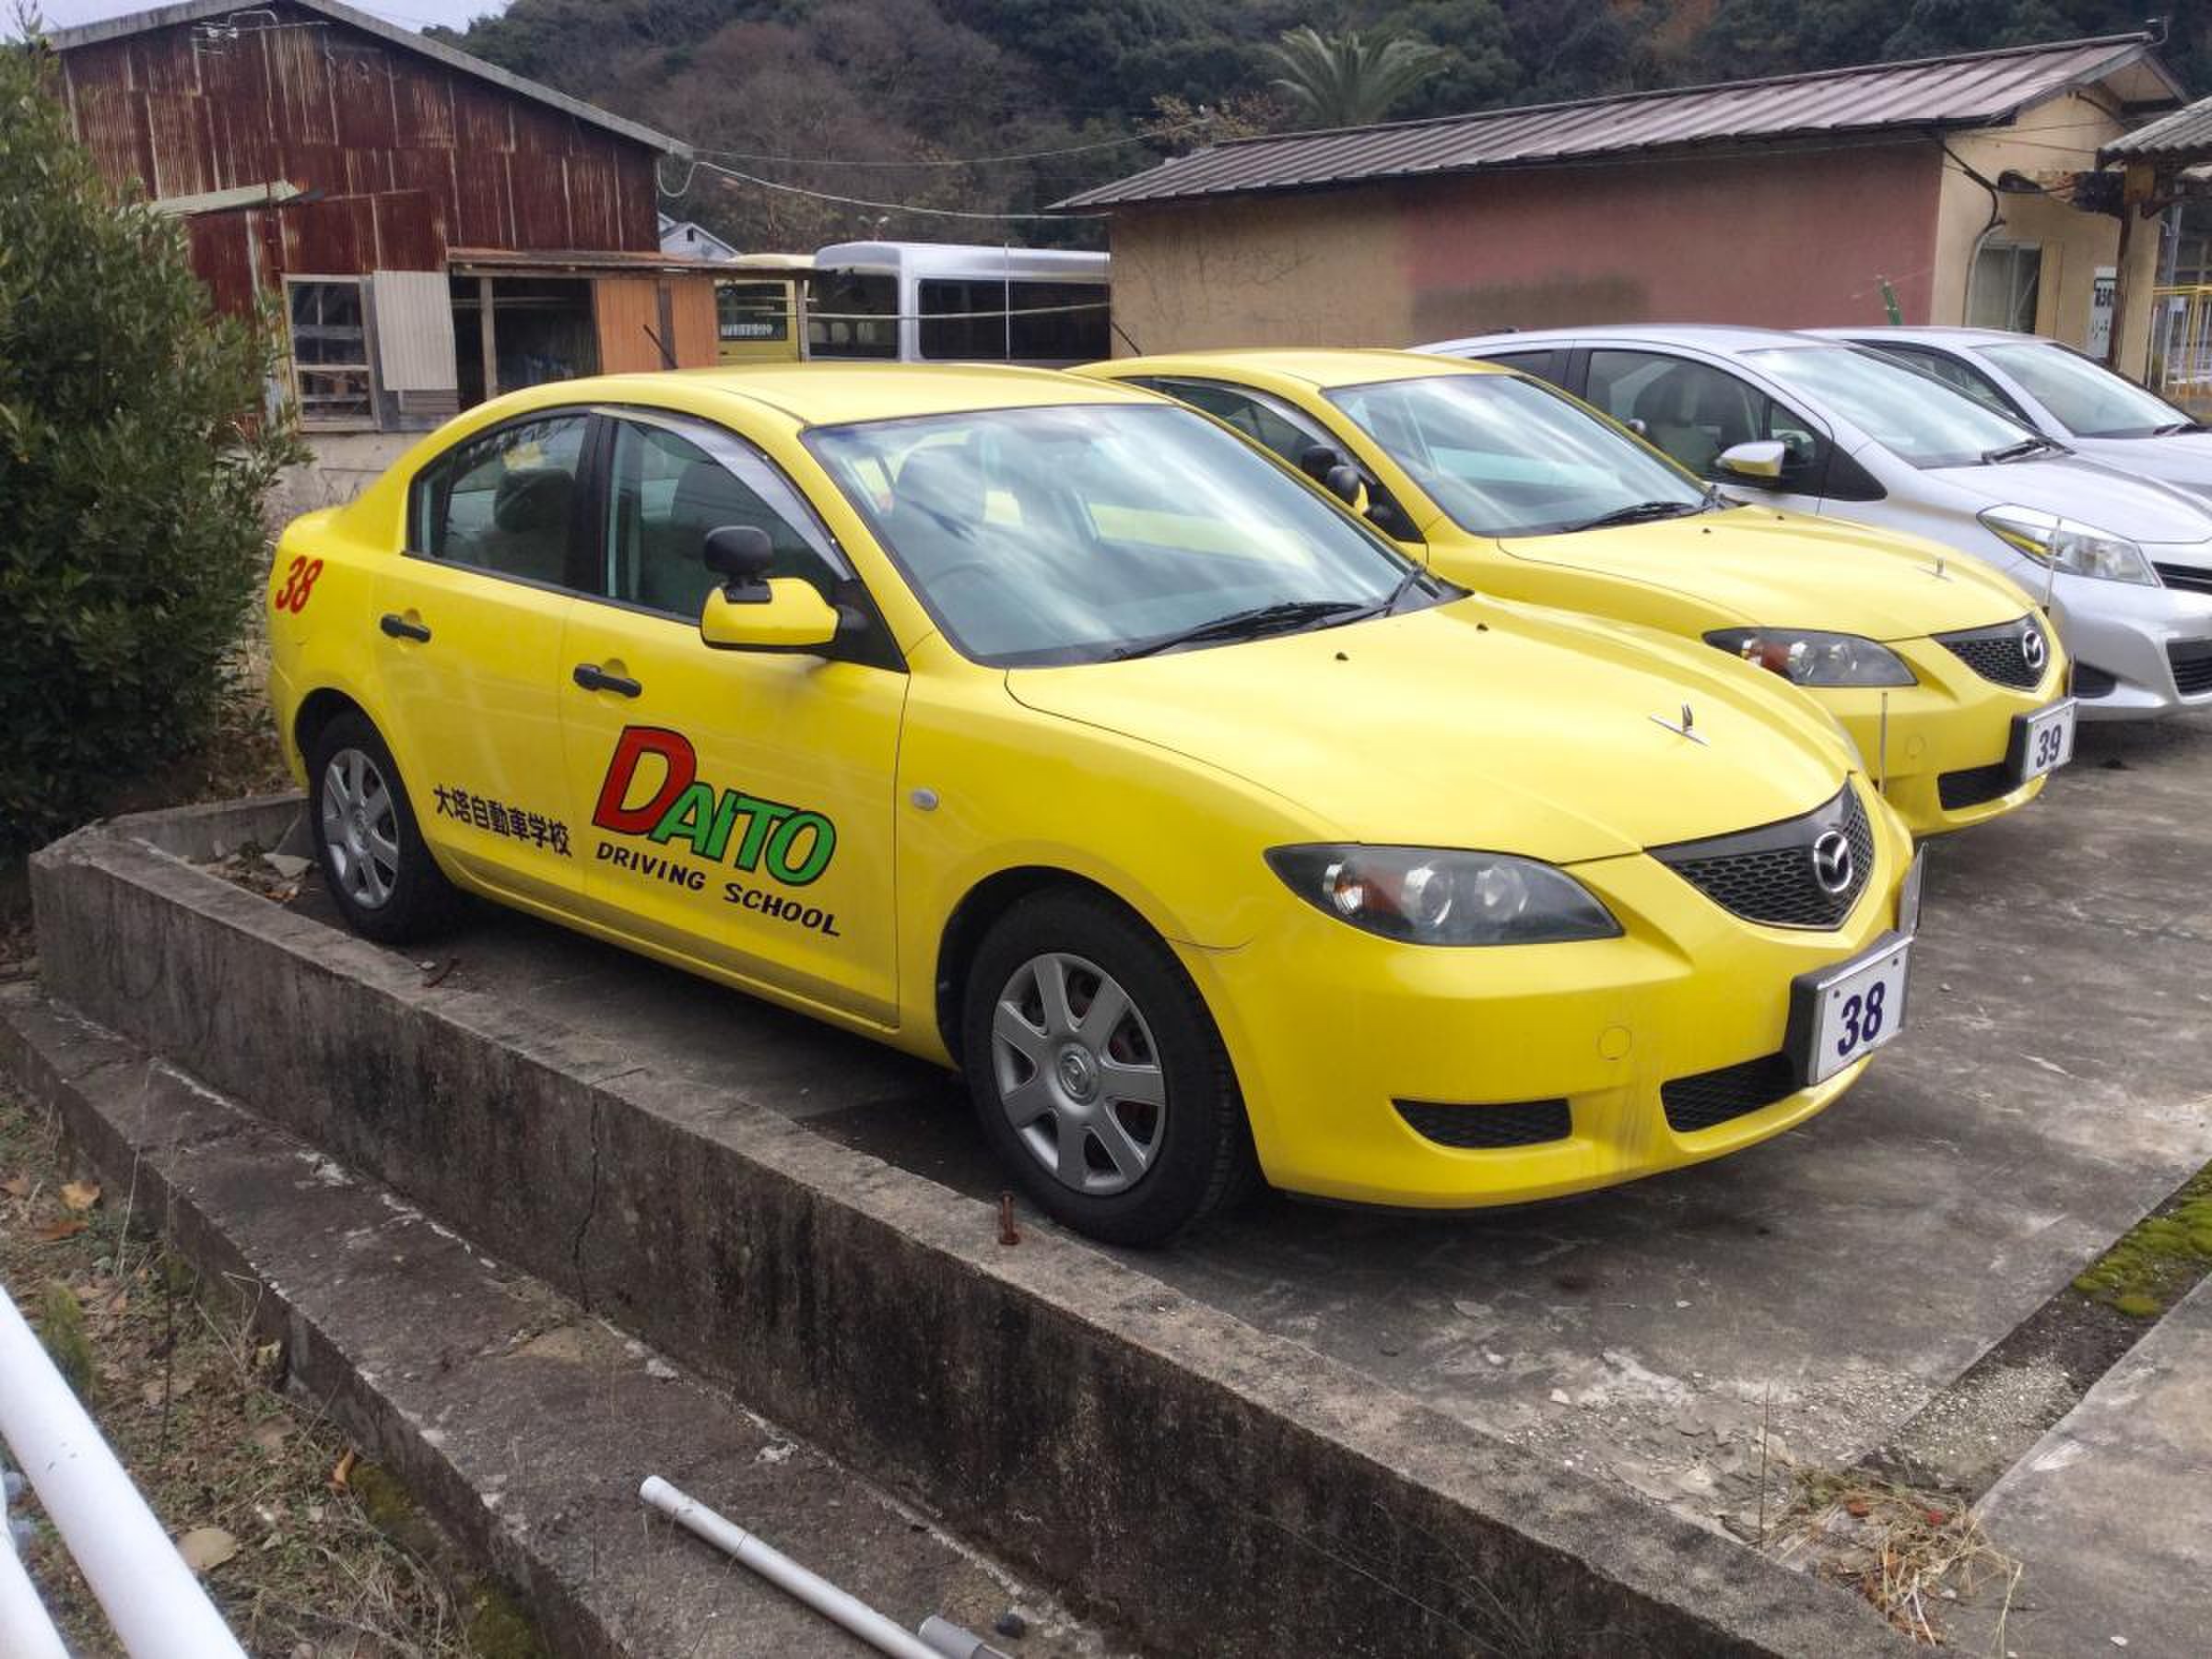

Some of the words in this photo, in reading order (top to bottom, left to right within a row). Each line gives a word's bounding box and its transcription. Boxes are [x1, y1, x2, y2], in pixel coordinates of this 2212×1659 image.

[276, 556, 323, 614] 38
[2036, 724, 2062, 768] 39
[433, 784, 572, 857] 大塔自動車学校
[592, 725, 836, 886] DAITO
[596, 842, 706, 891] DRIVING
[724, 883, 841, 936] SCHOOL
[1838, 982, 1885, 1055] 38
